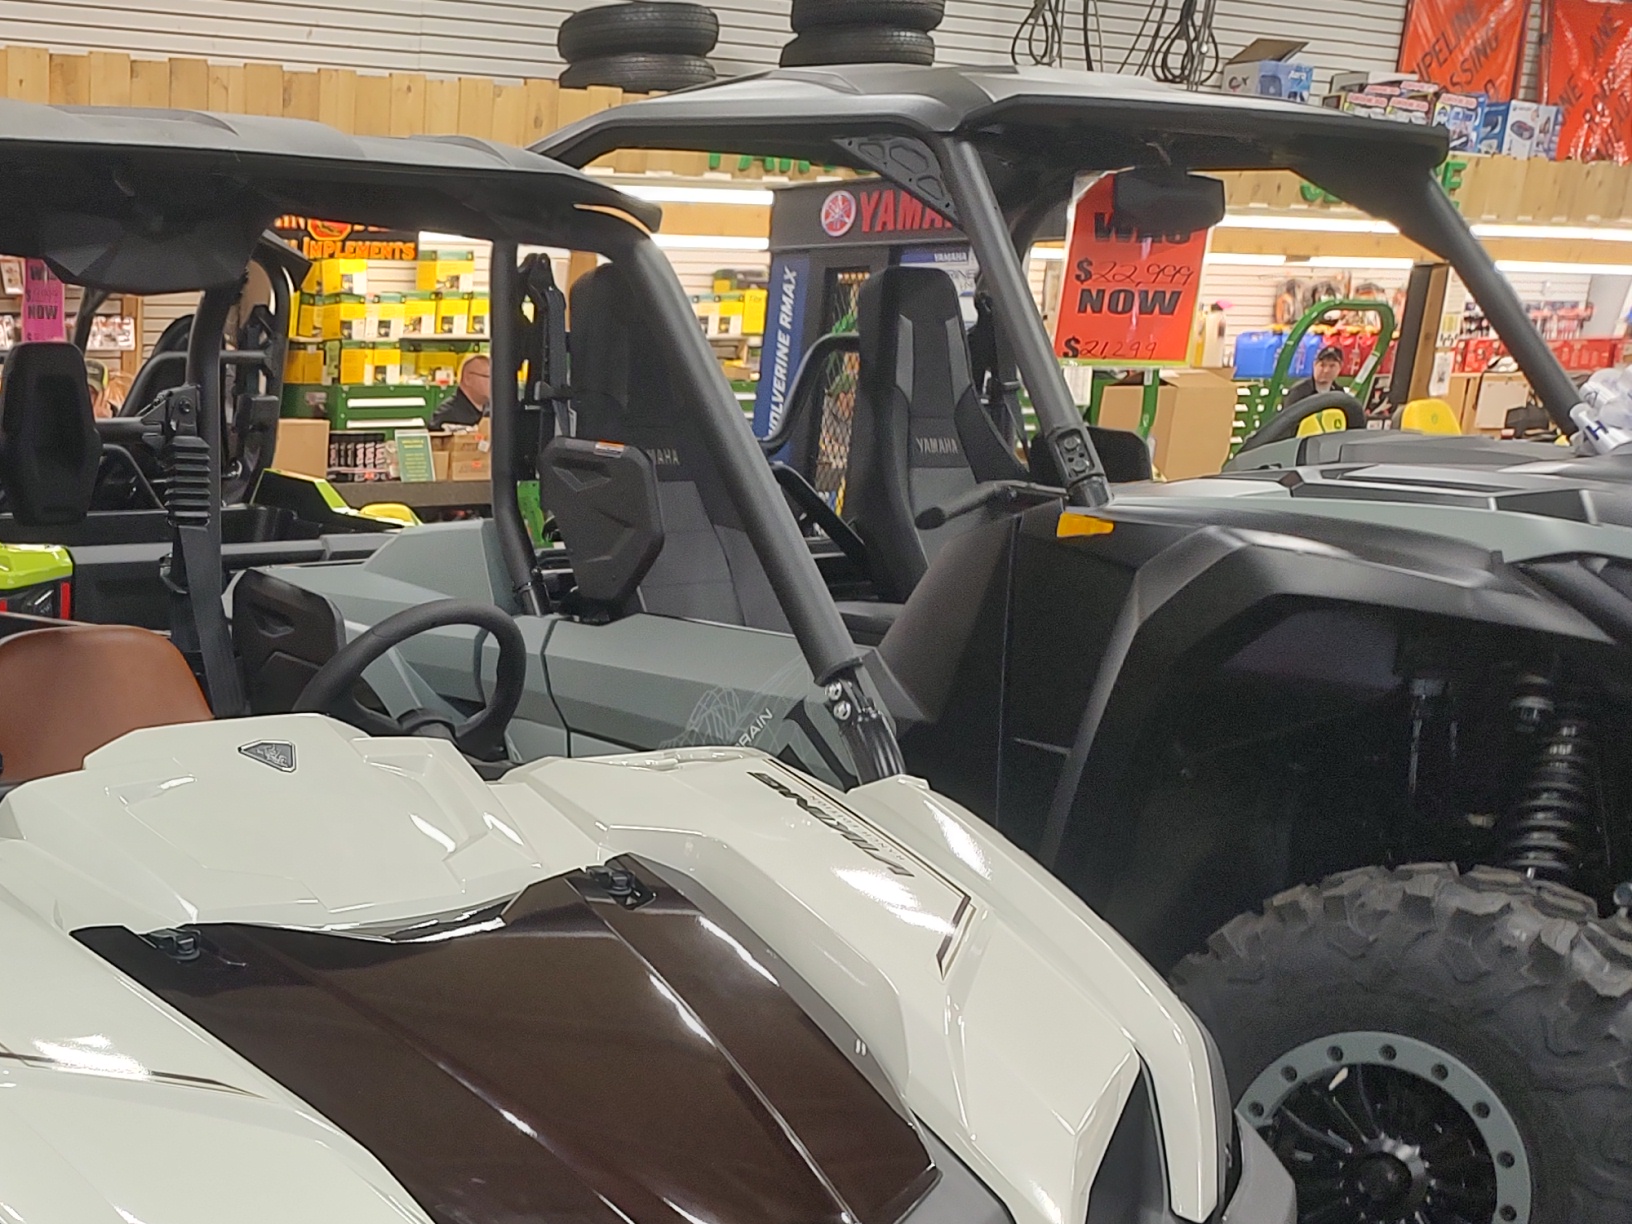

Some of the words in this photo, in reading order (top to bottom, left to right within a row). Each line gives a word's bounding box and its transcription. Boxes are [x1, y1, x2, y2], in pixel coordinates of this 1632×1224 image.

[859, 189, 953, 233] YAMA
[303, 237, 416, 260] IMPLEMENTS
[778, 265, 797, 329] RMAX
[1077, 289, 1182, 316] NOW
[27, 305, 58, 320] NOW
[647, 448, 680, 466] MAHA
[916, 438, 958, 454] YAMAHA
[735, 707, 773, 748] RAIN
